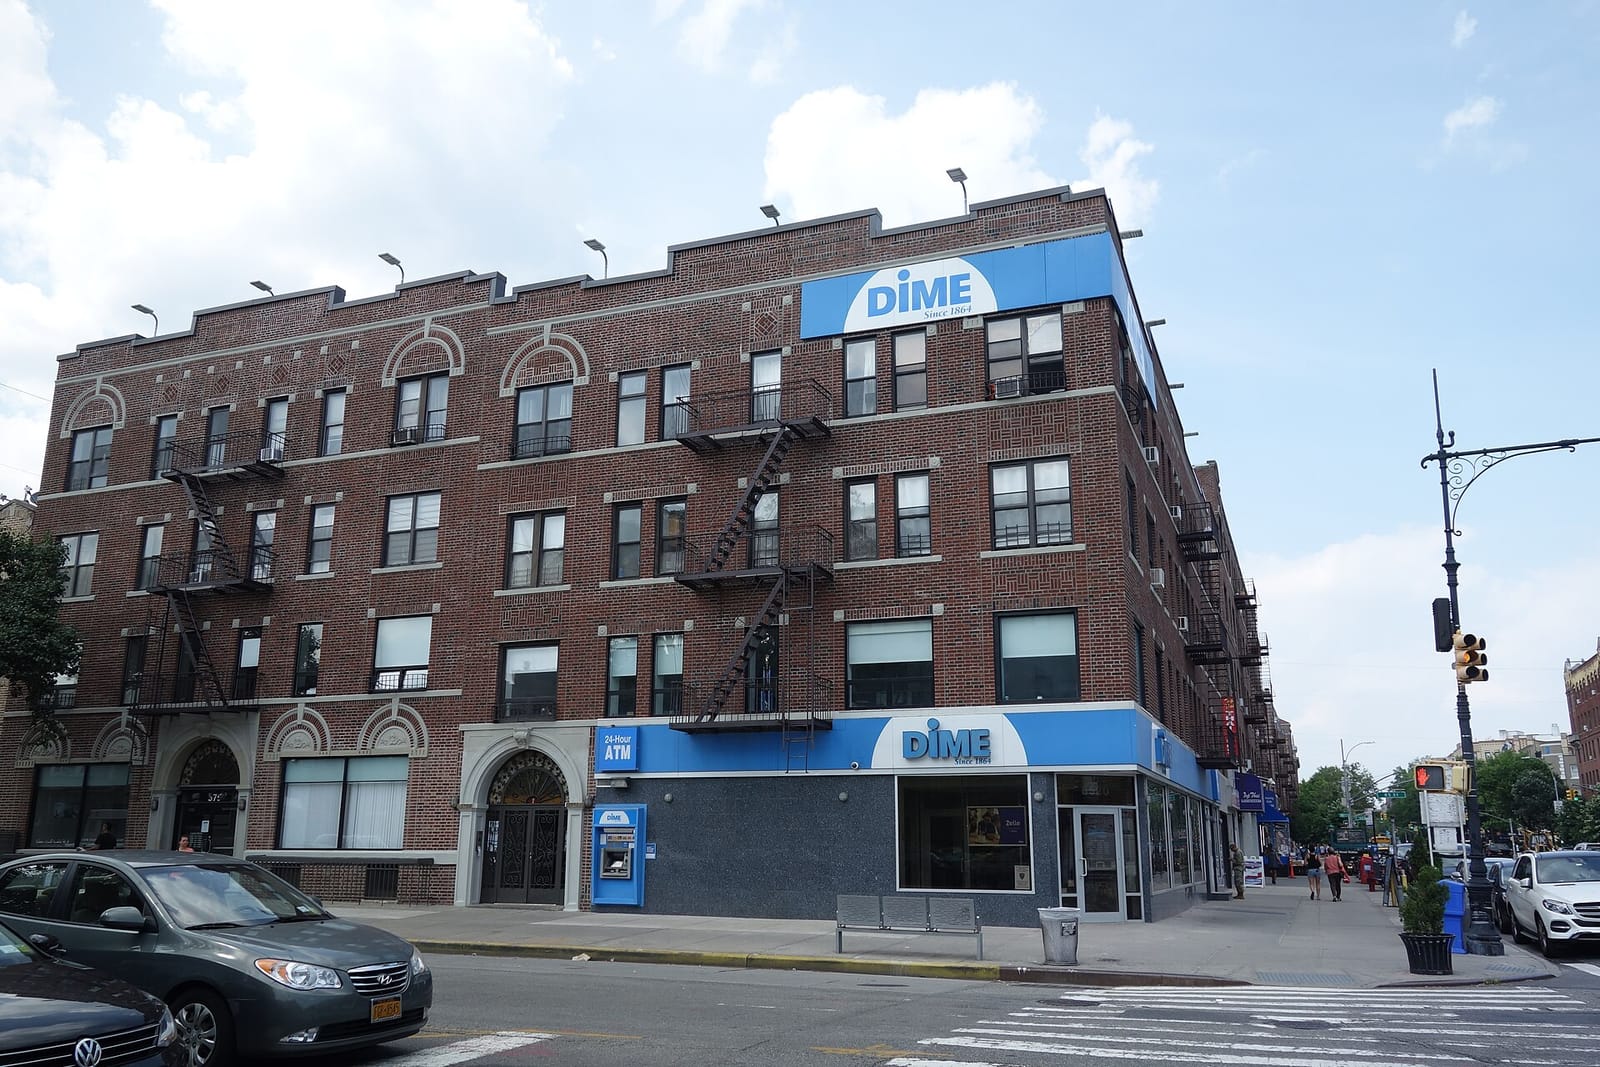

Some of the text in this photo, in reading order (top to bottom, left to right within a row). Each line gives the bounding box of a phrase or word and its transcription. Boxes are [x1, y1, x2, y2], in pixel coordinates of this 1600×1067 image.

[924, 305, 972, 319] Since 1864
[604, 735, 631, 744] 24-Hour
[604, 744, 631, 760] ATM
